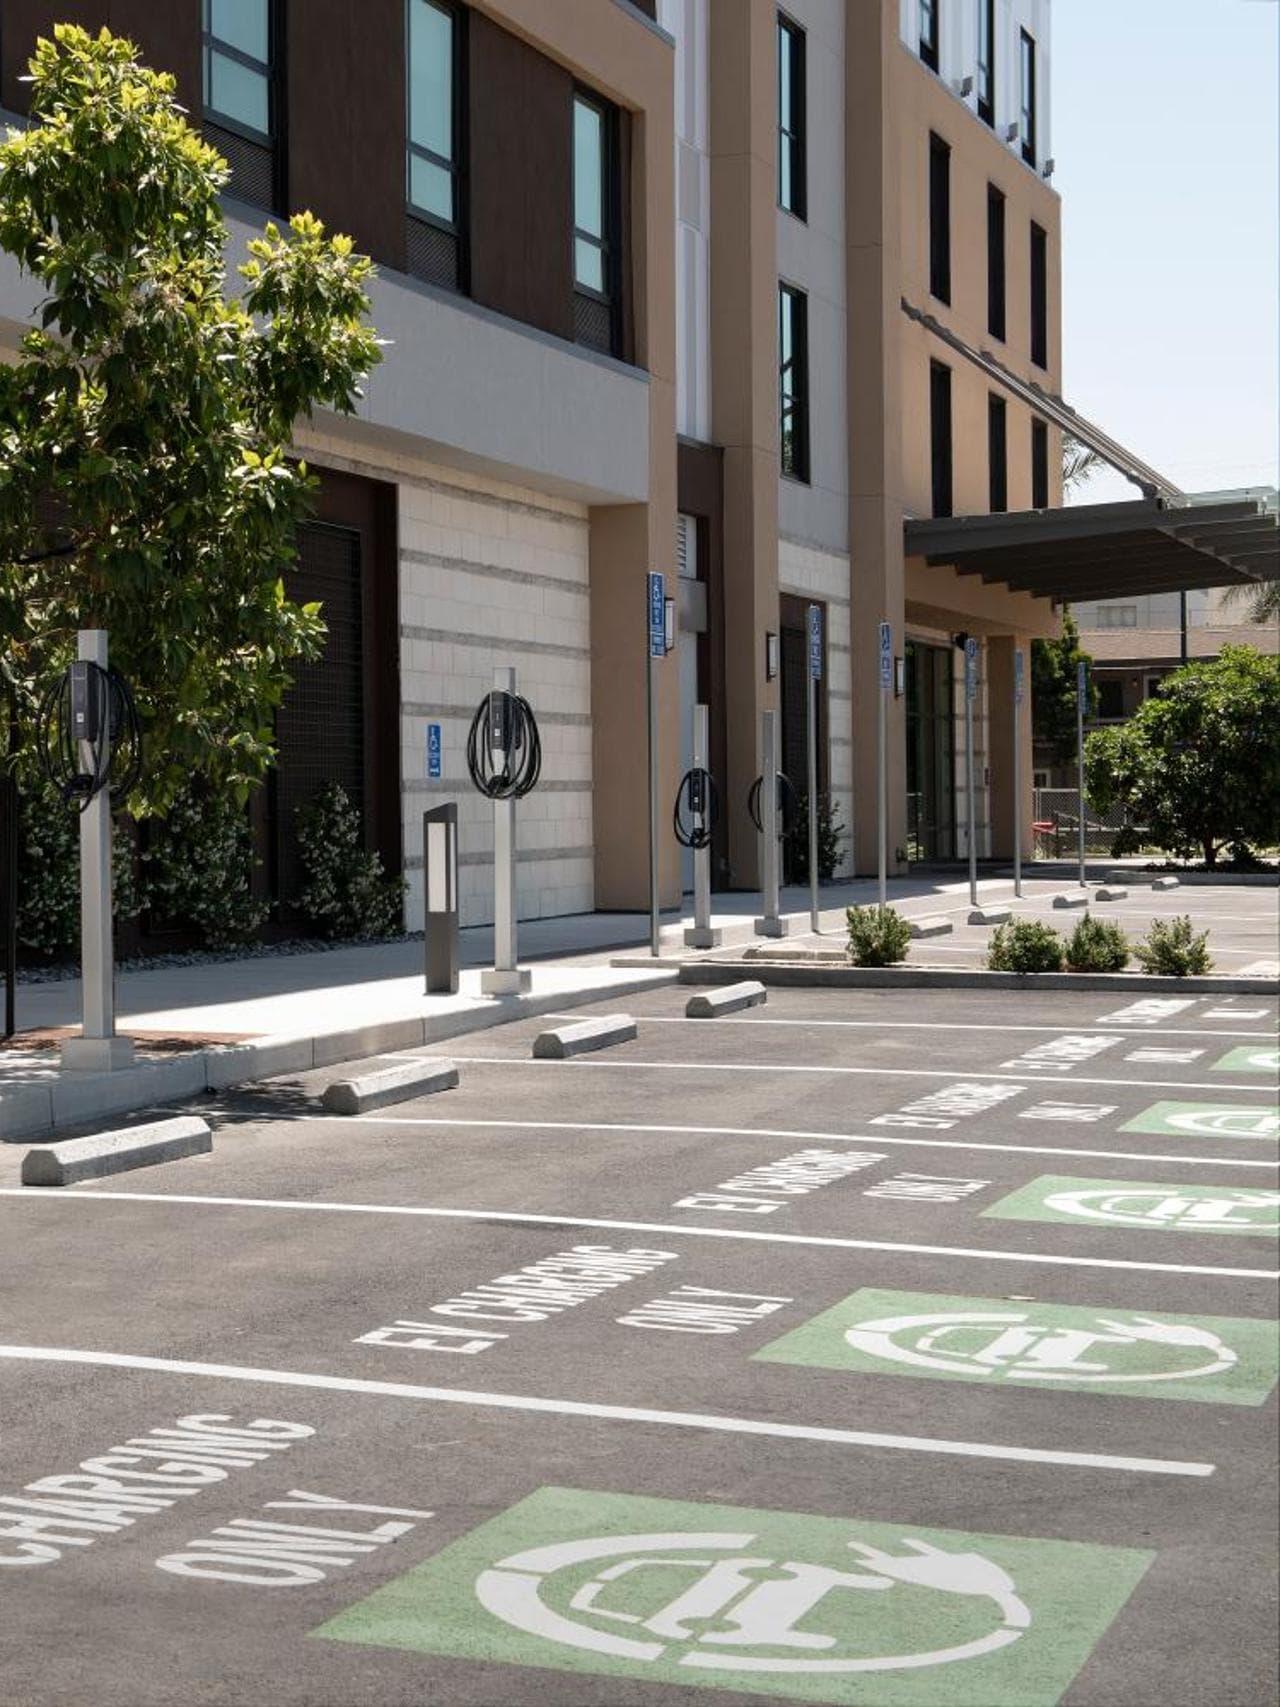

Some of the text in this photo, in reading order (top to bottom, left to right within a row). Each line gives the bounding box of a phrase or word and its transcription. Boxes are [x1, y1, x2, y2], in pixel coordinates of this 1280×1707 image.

[352, 1245, 680, 1355] EV CHARGING
[615, 1285, 794, 1334] ONLY
[155, 1489, 434, 1587] ONLY
